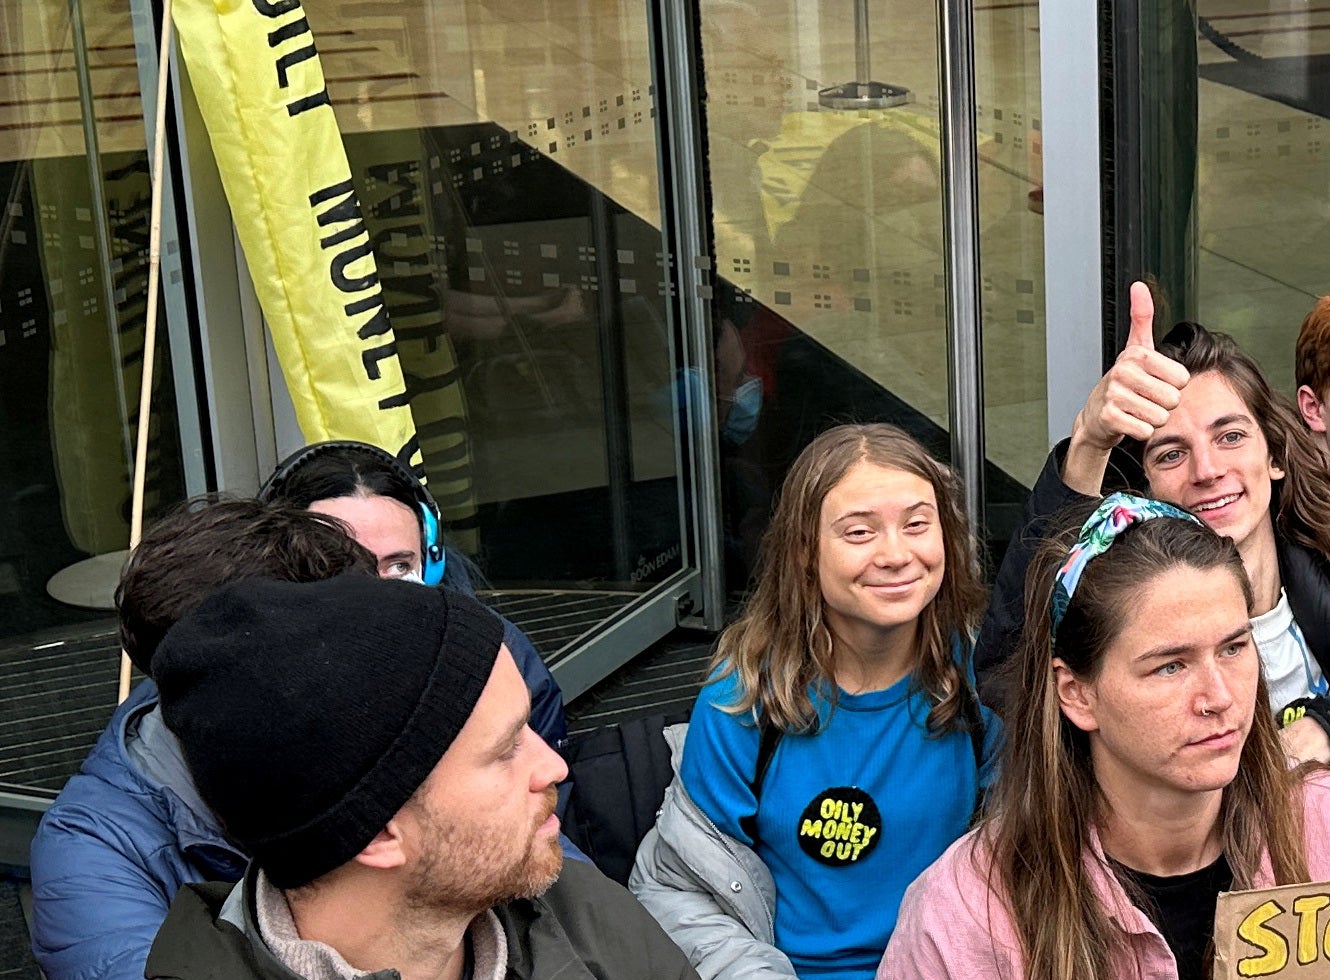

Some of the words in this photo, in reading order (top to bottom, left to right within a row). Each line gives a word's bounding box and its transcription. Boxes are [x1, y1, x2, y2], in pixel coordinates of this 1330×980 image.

[820, 798, 864, 823] OILY
[800, 819, 877, 847] MONEY
[820, 840, 864, 861] OUT
